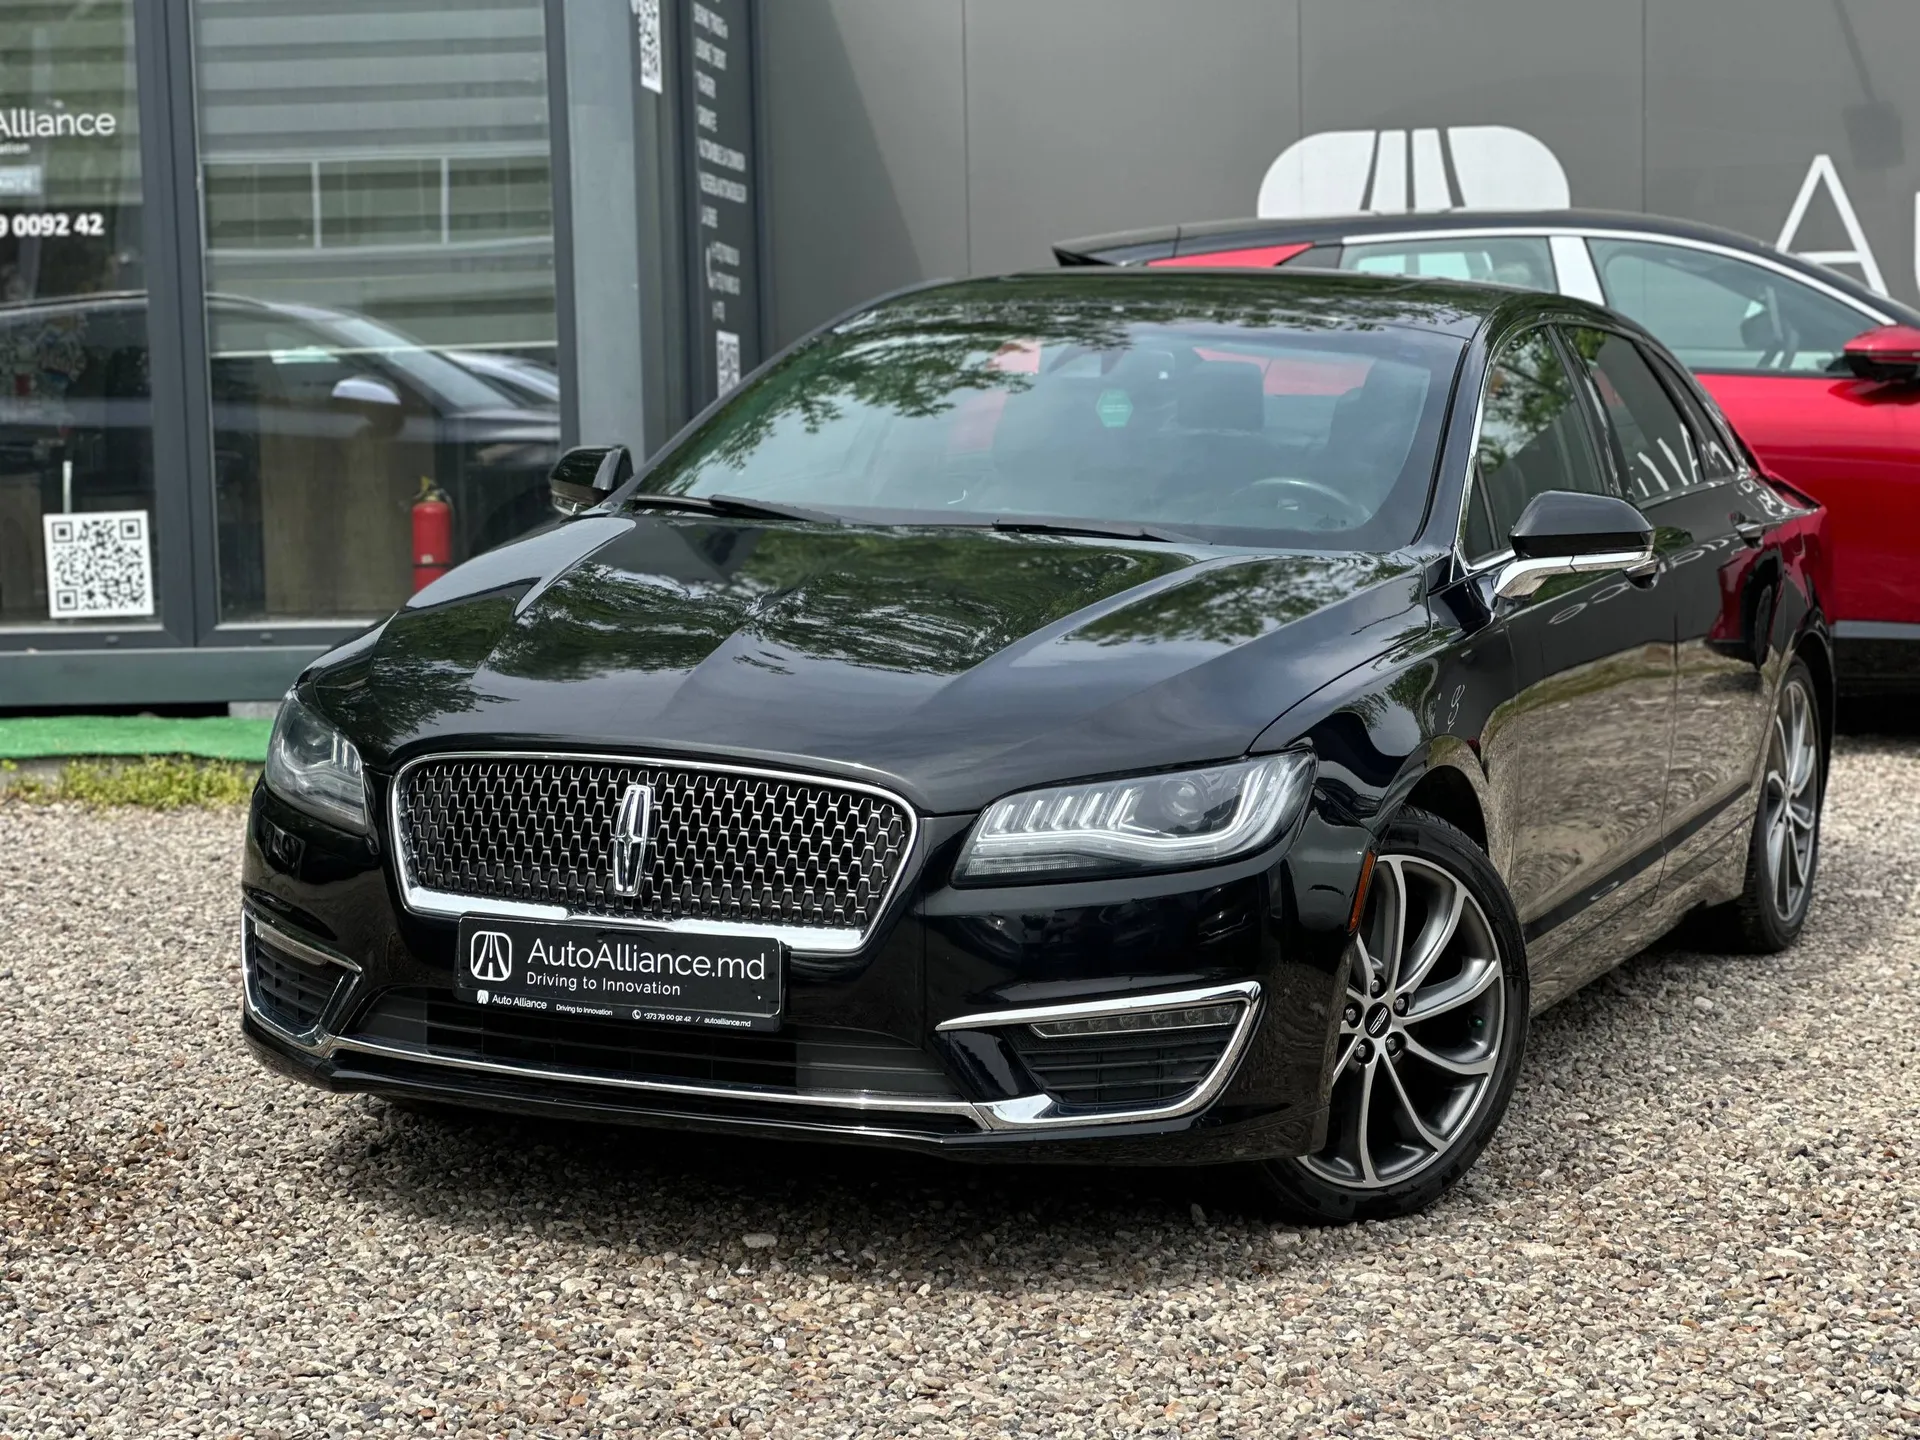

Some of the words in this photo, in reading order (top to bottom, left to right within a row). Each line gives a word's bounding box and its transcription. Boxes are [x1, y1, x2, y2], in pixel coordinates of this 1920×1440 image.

[12, 212, 70, 237] 0092
[73, 212, 105, 236] 42
[527, 937, 765, 980] AutoAlliance.md
[526, 971, 577, 991] Driving
[582, 976, 597, 990] to
[602, 977, 681, 996] Innovation
[492, 994, 512, 1006] Auto
[513, 997, 547, 1010] Alliance
[556, 1003, 576, 1014] Driving
[576, 1005, 583, 1013] to
[583, 1007, 613, 1016] Innovation
[657, 1013, 665, 1021] 79
[683, 1015, 692, 1023] 42
[703, 1017, 751, 1028] autoalliance.md
